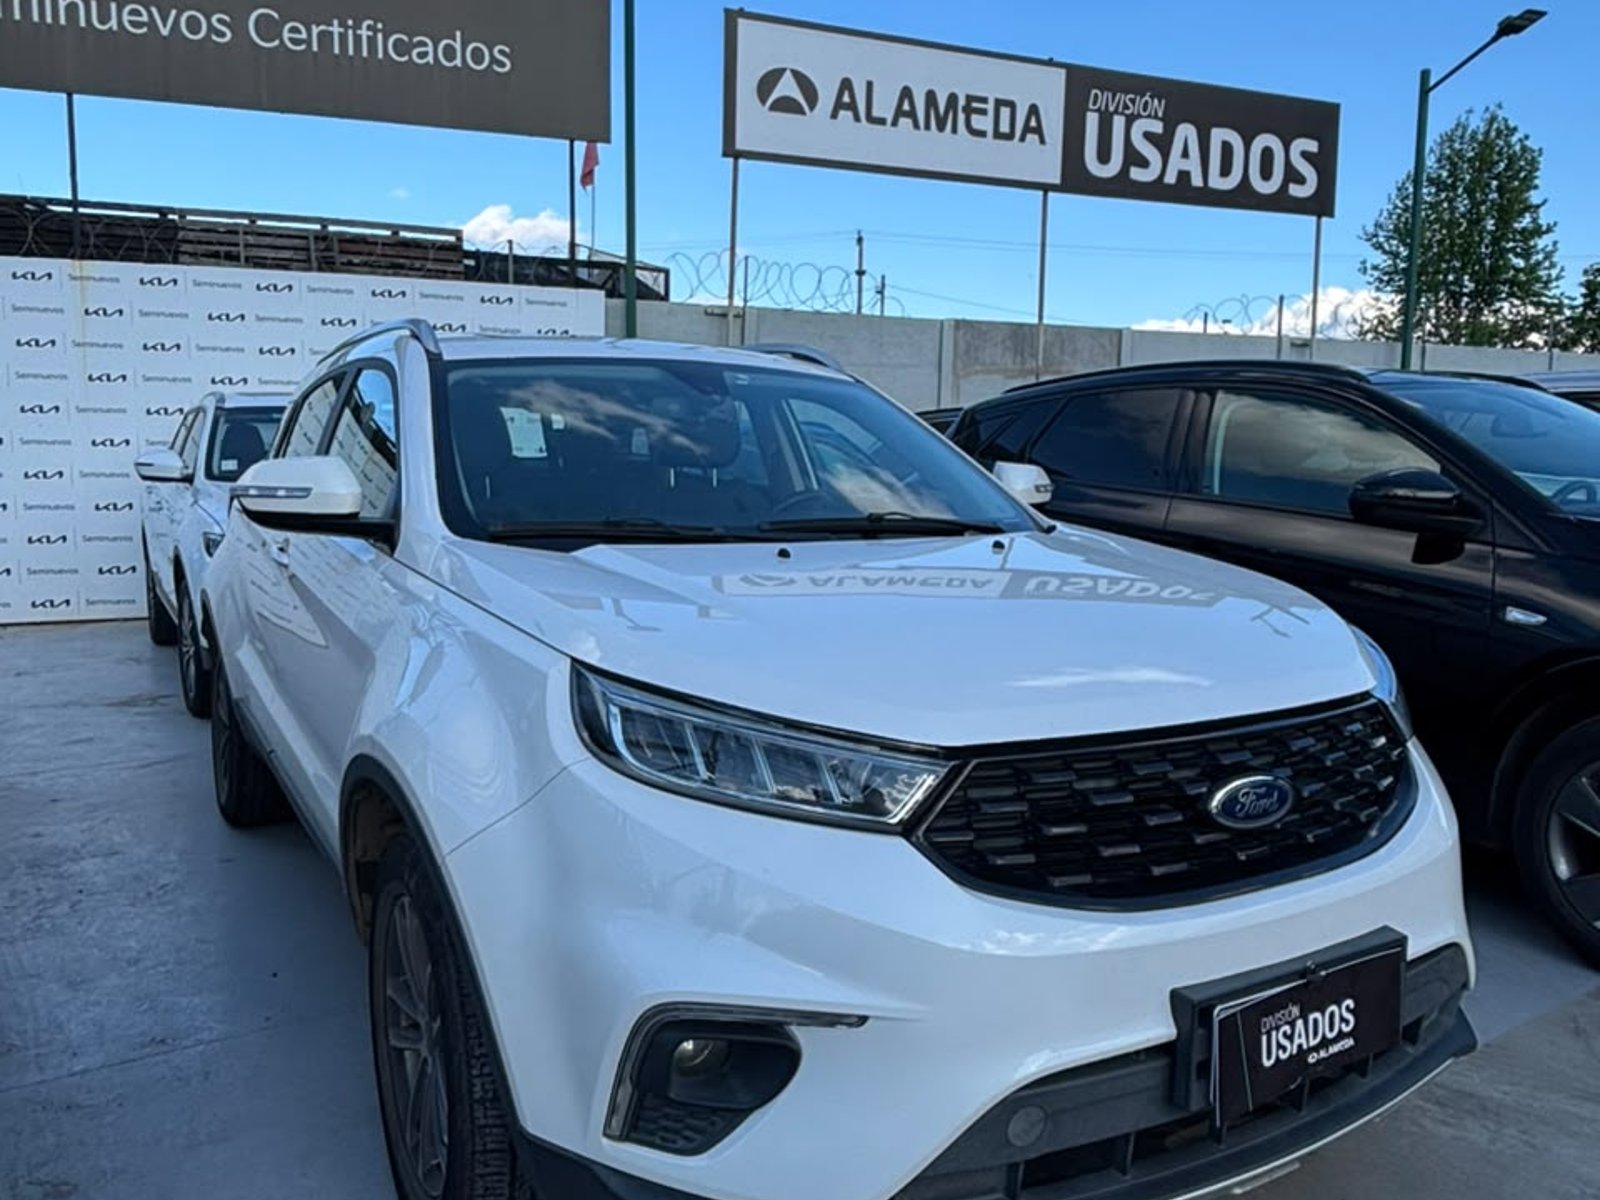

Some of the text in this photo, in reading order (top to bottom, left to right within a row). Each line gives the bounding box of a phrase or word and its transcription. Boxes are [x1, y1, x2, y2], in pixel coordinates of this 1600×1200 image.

[248, 7, 512, 73] Certificados
[829, 76, 1047, 146] ALAMEDA
[1088, 88, 1166, 119] DIVISIÓN
[1084, 111, 1320, 199] USADOS
[1235, 786, 1278, 818] Ford
[1261, 998, 1356, 1067] USADOS
